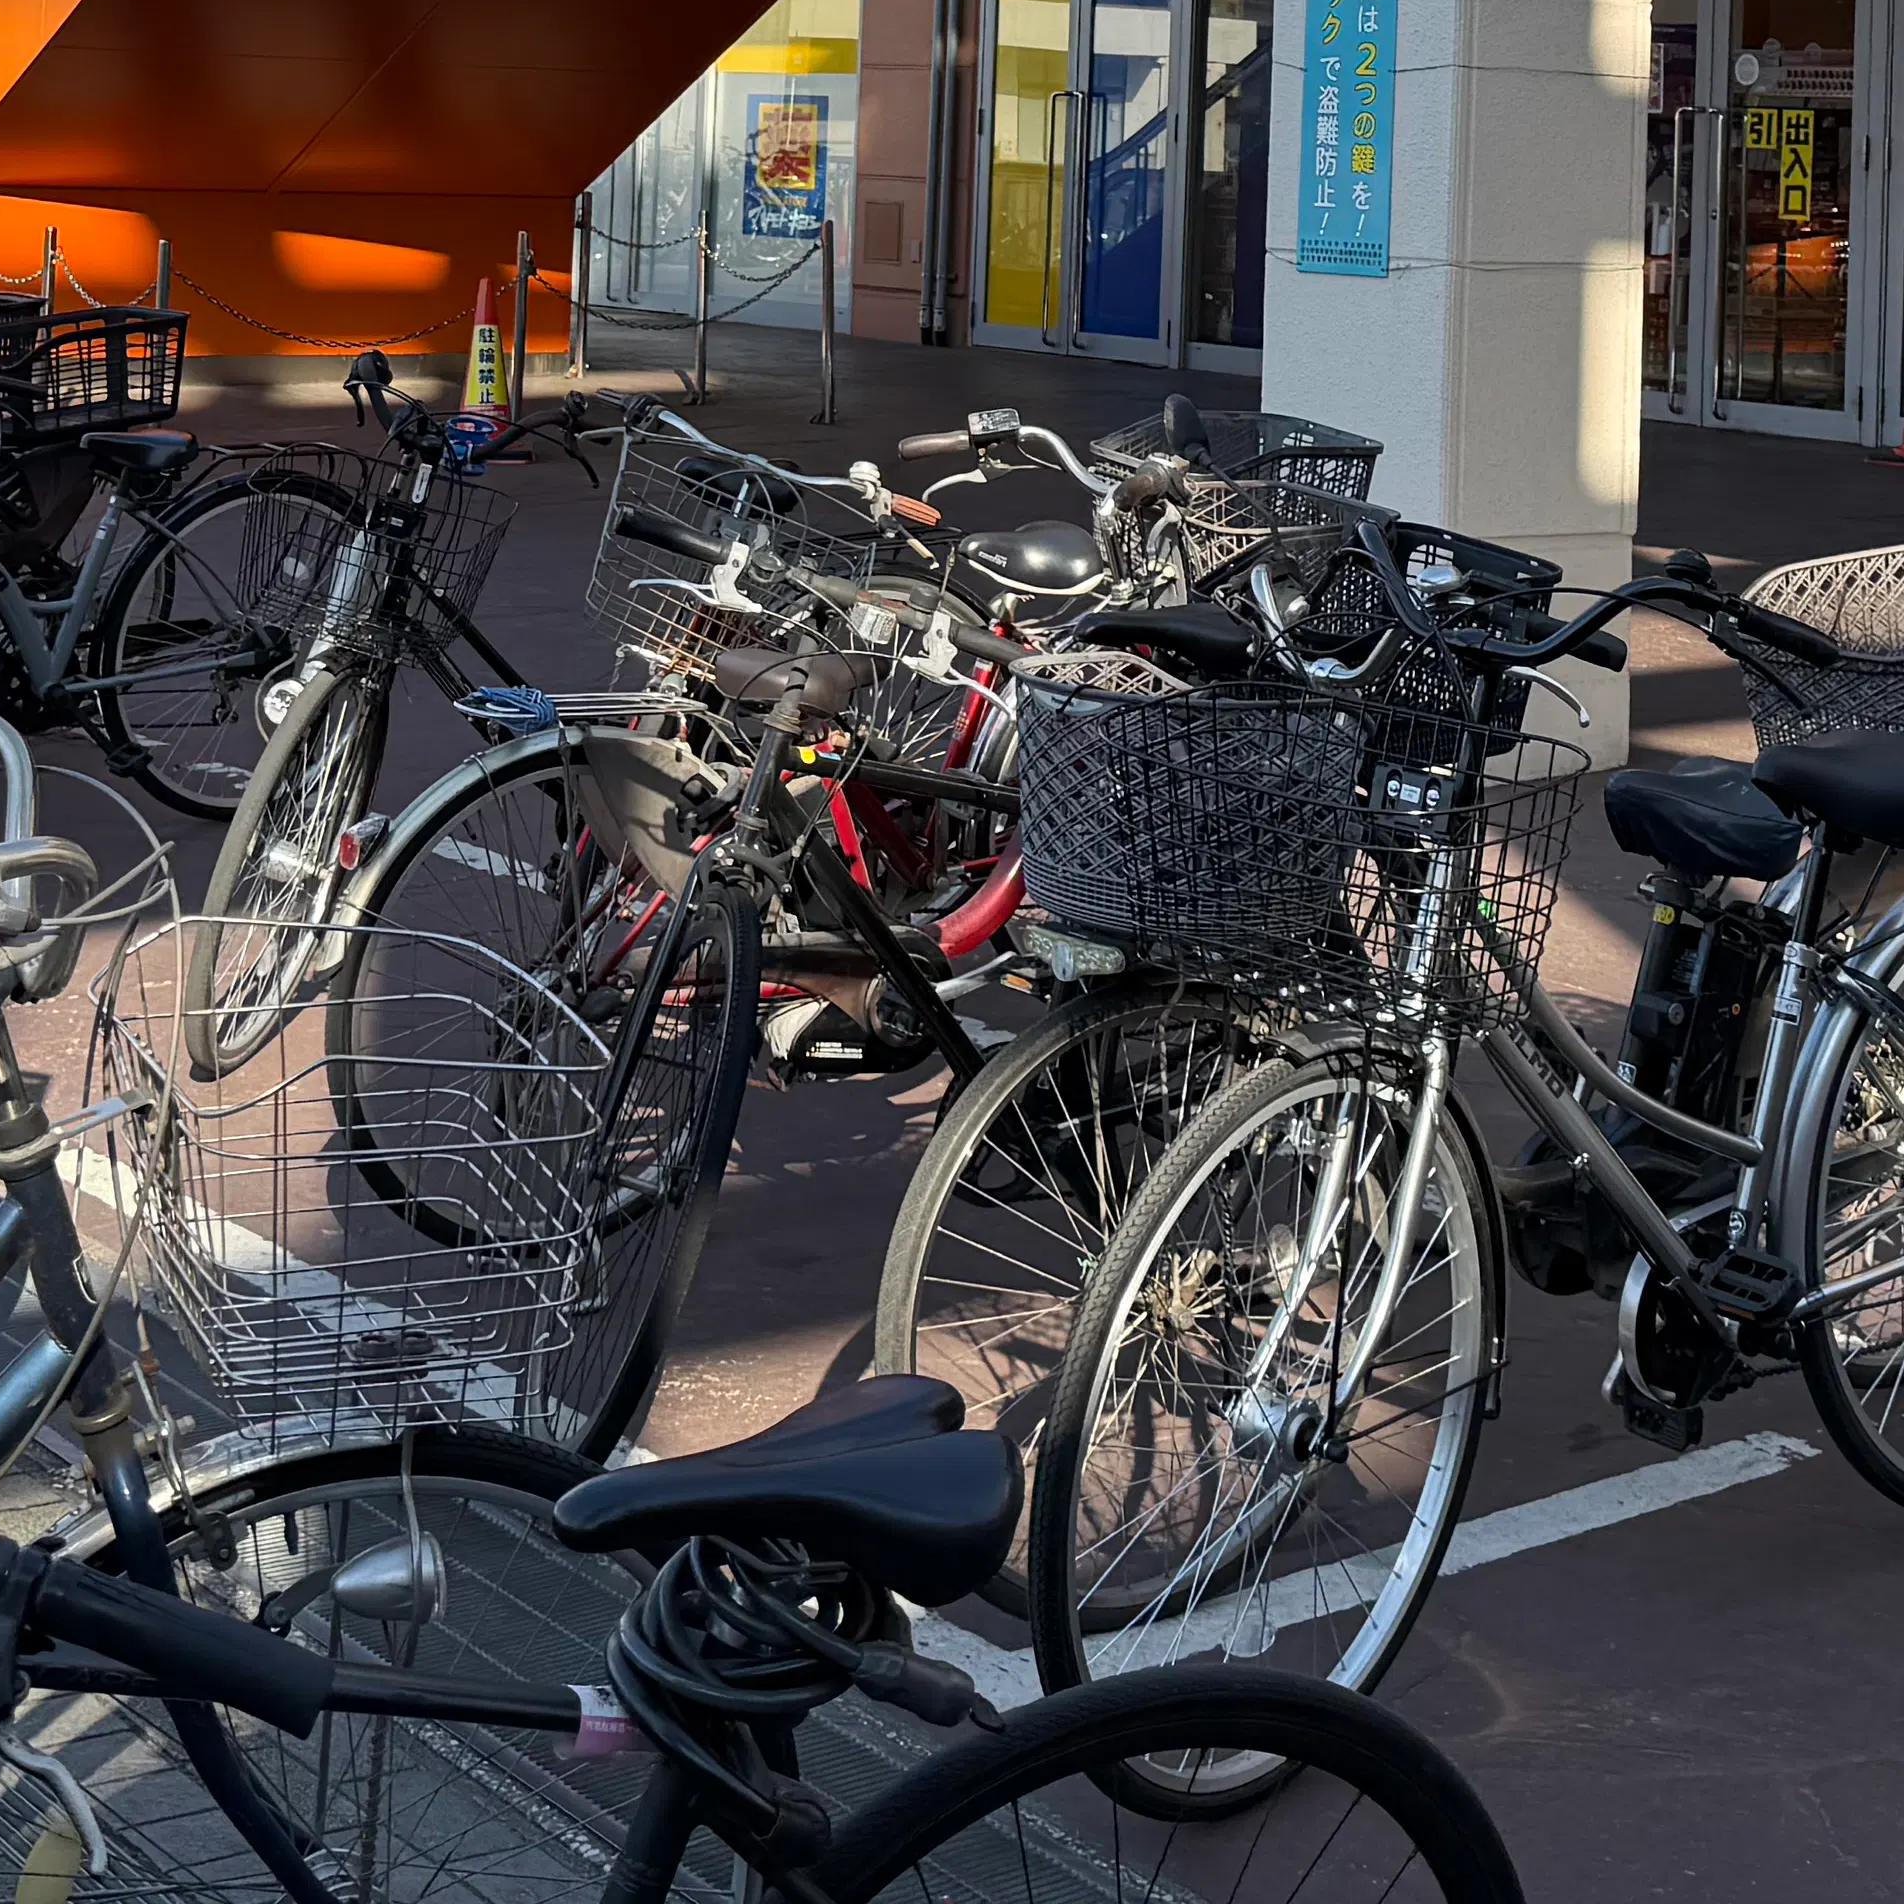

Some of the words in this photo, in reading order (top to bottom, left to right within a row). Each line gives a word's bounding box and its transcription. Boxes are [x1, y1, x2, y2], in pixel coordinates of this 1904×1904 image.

[1748, 111, 1777, 148] 引
[1783, 112, 1813, 220] 出入口
[478, 328, 496, 404] 駐輪禁止
